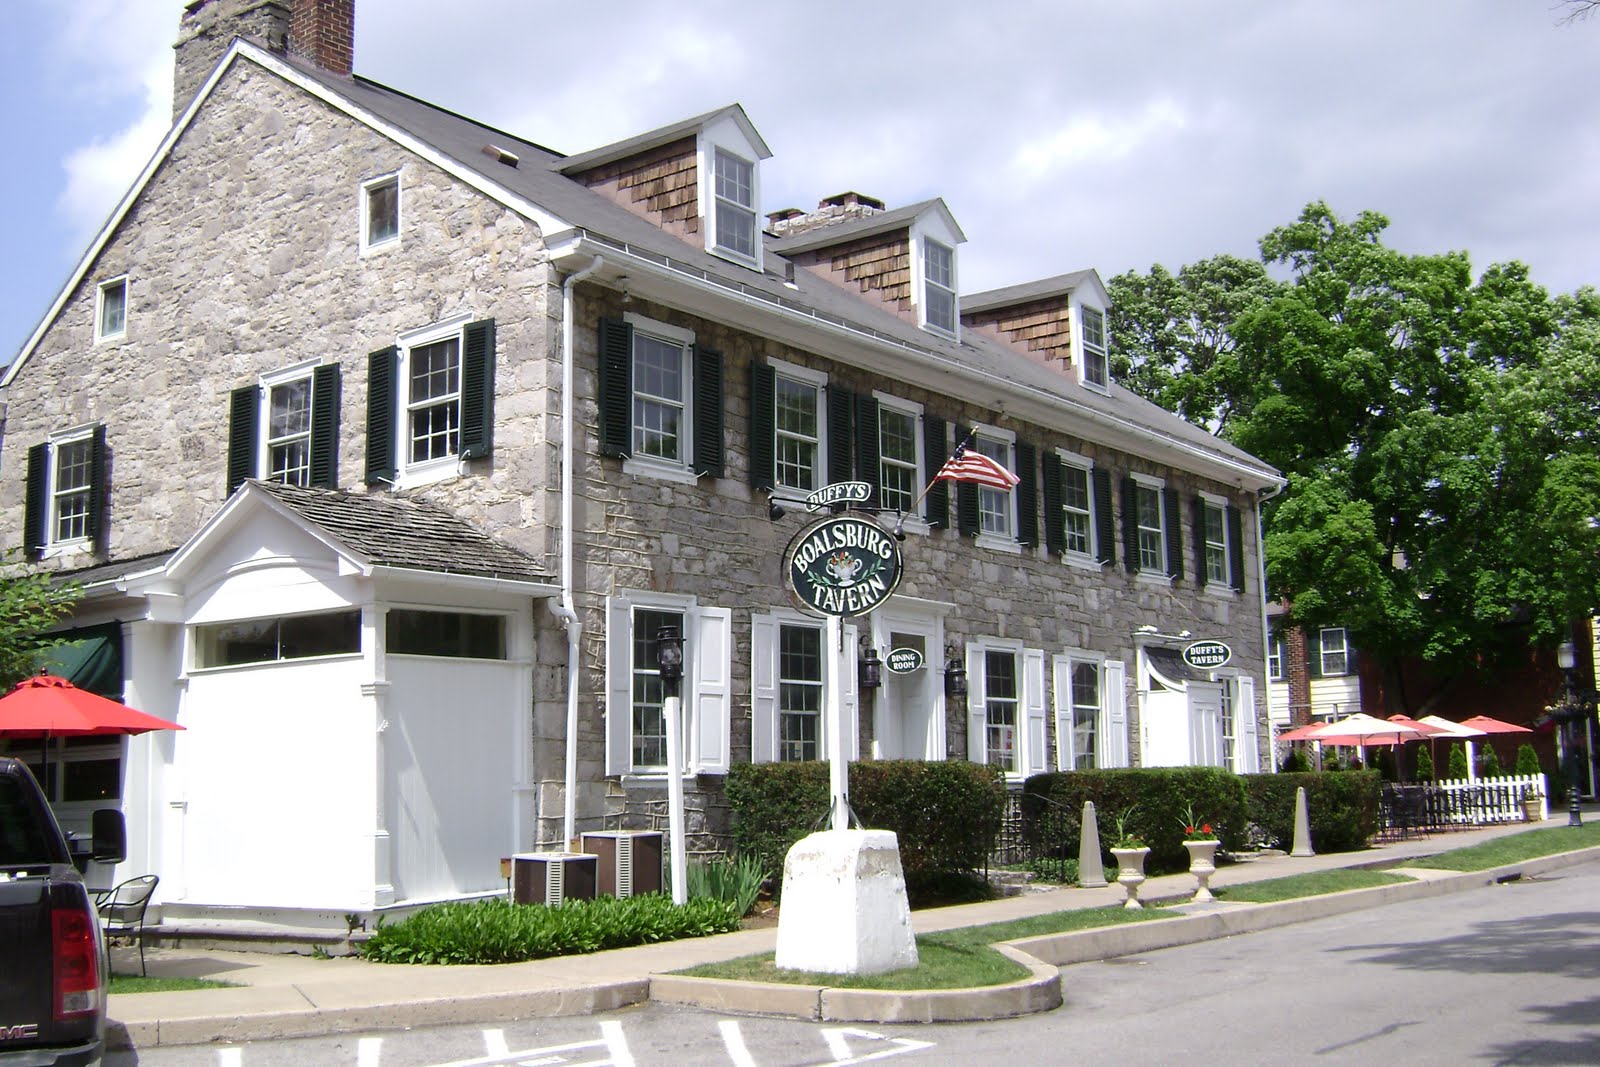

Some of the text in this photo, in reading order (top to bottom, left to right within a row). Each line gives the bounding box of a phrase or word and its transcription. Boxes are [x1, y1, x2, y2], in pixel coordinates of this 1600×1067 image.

[810, 484, 866, 509] DUFFY'S
[794, 524, 892, 573] BOALSBURG
[812, 574, 886, 612] TAVERN
[1190, 646, 1224, 655] DUFFY'S
[891, 653, 916, 662] DINING
[1191, 655, 1224, 664] TAVERN
[893, 661, 915, 670] ROOM
